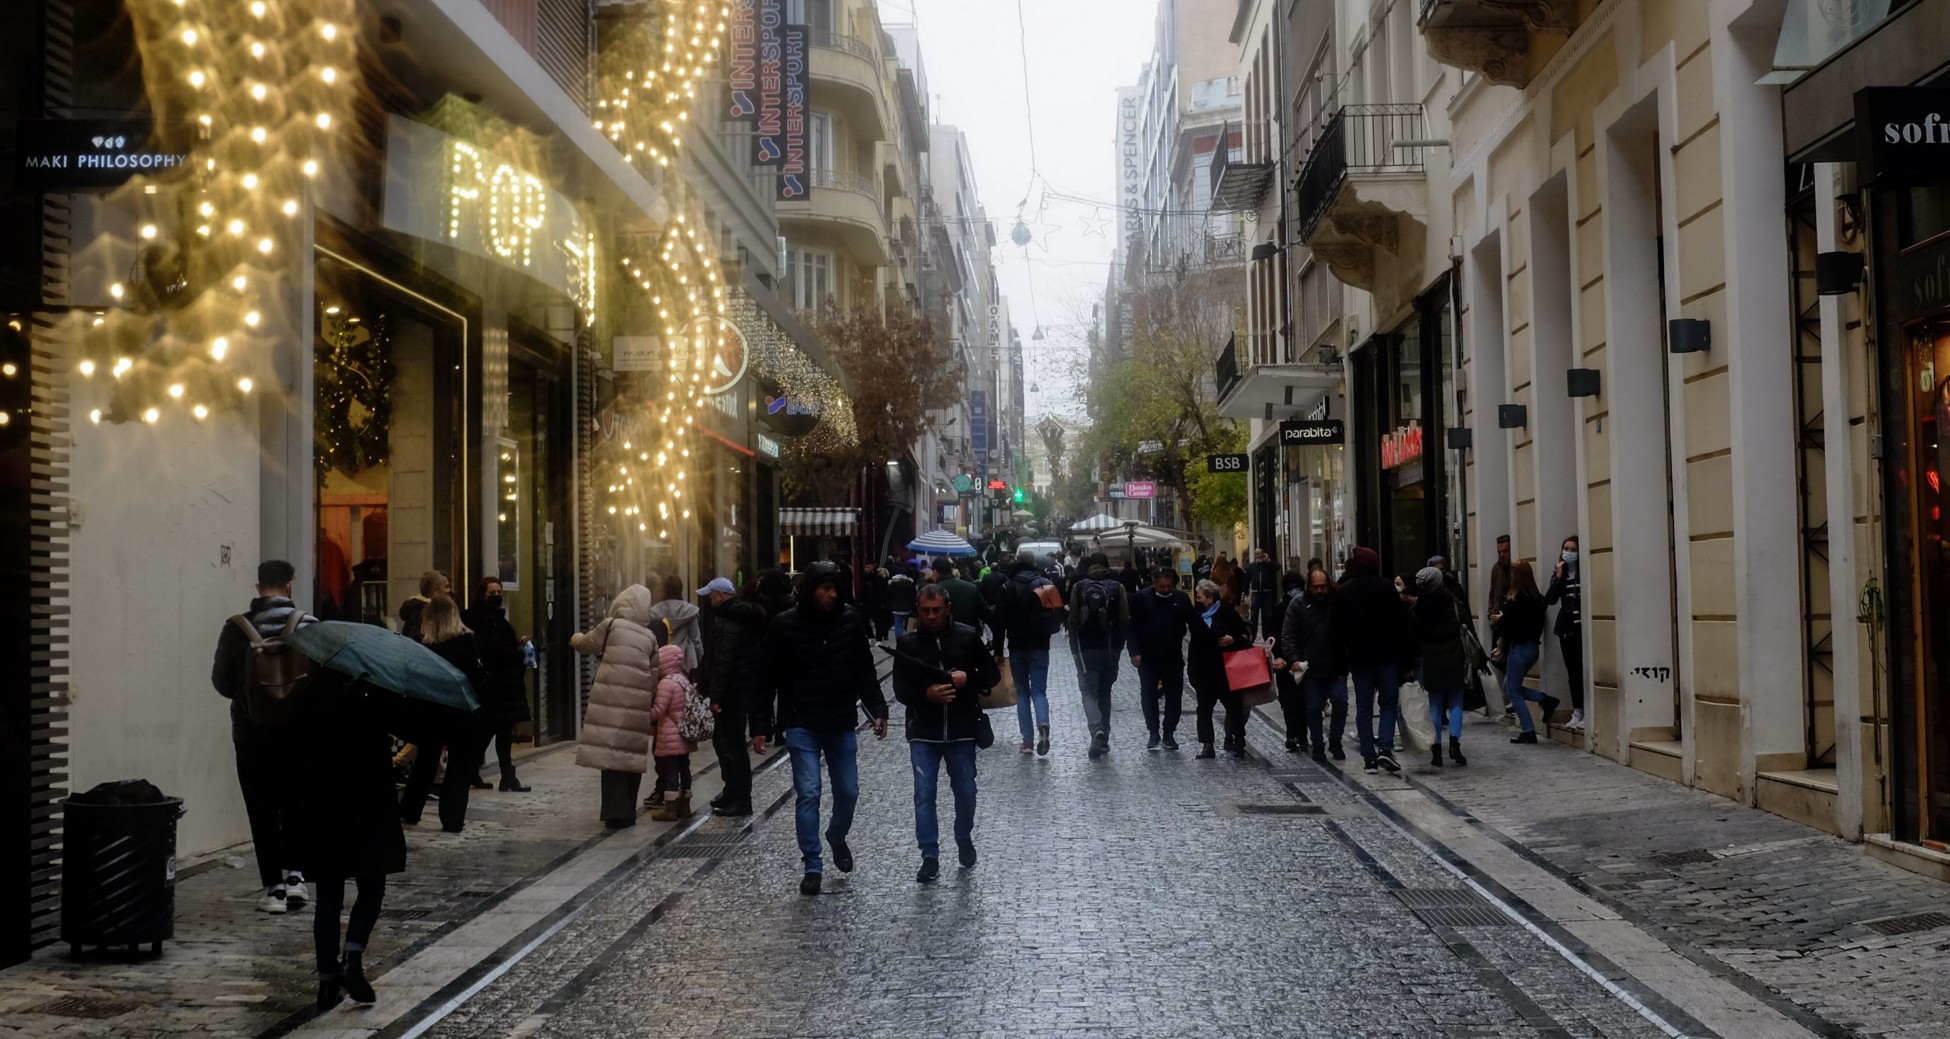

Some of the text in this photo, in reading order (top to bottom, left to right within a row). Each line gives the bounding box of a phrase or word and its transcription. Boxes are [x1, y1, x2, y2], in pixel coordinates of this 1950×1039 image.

[783, 30, 804, 174] INTERSPORT
[1122, 97, 1138, 180] SPENCER
[25, 154, 187, 169] MAKI PHILOSOPHY
[1125, 183, 1138, 195] &
[1285, 426, 1332, 440] parabita
[1215, 457, 1241, 470] BSB
